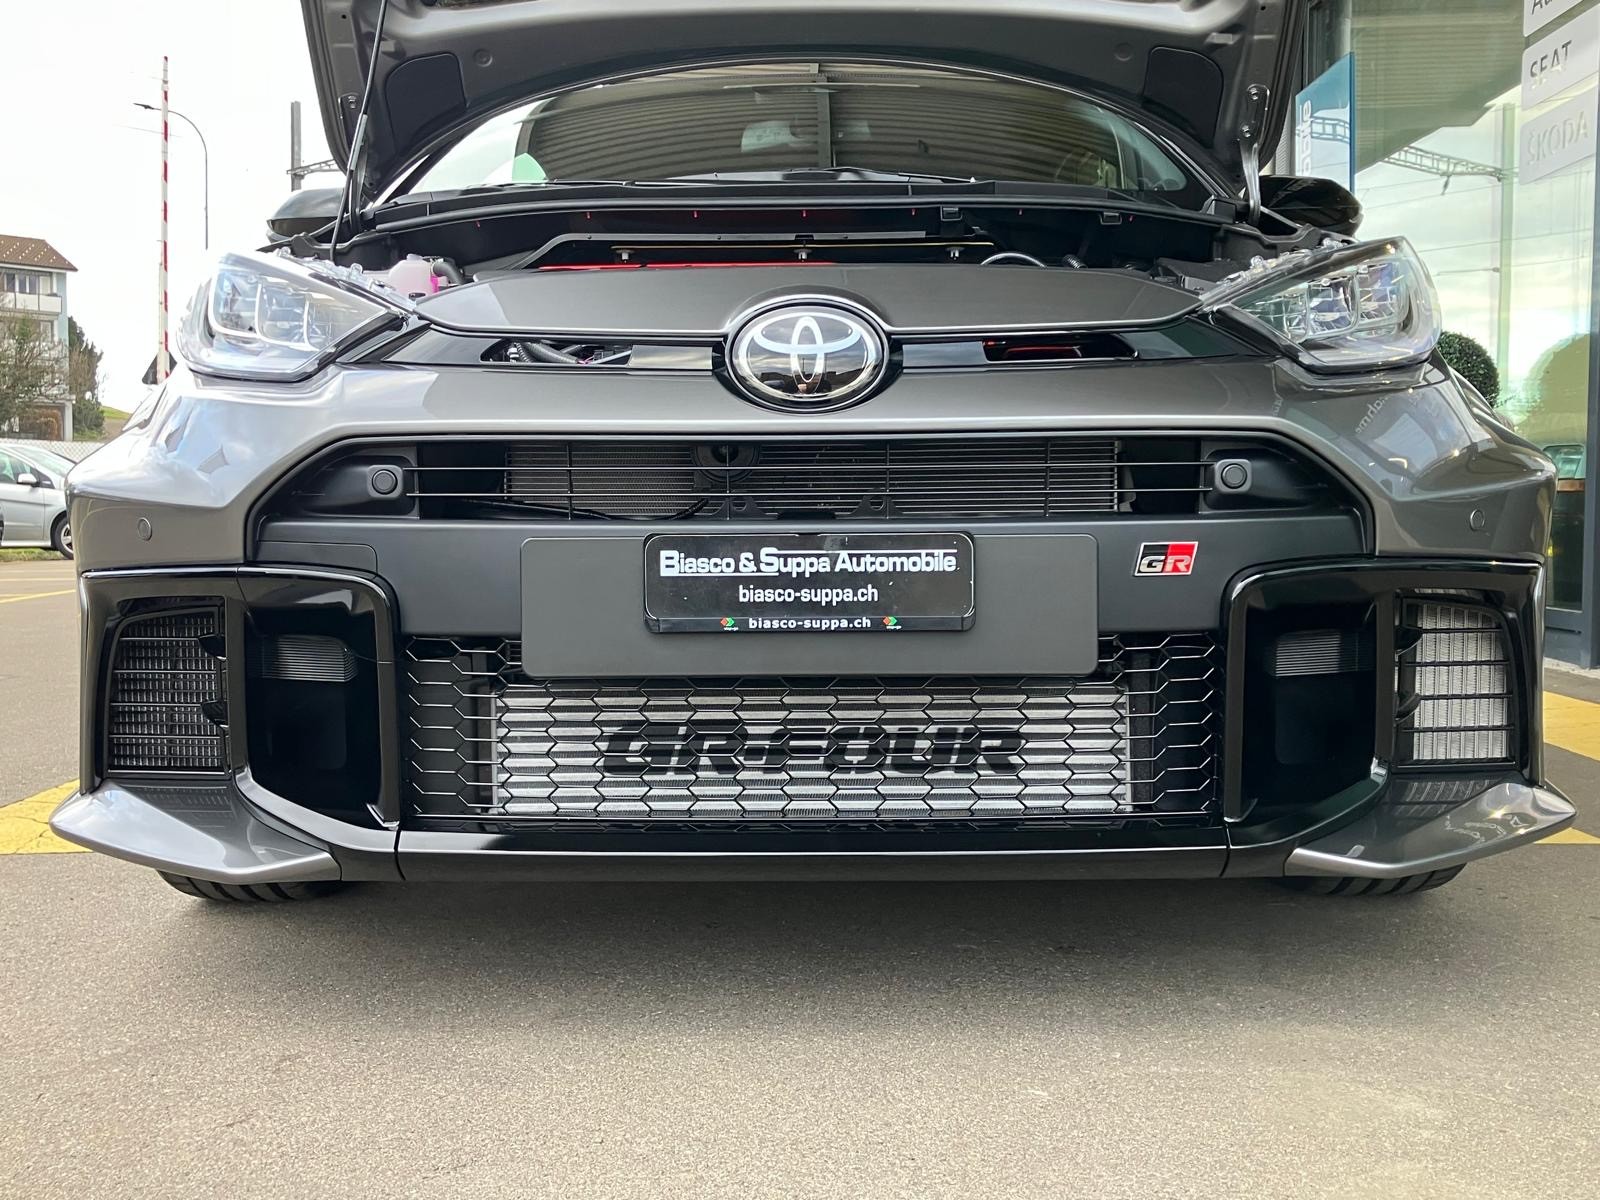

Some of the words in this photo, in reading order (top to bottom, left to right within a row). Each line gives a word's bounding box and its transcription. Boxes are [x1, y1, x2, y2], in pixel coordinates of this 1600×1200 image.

[1530, 40, 1572, 86] SEAT
[660, 550, 735, 576] Biasco
[739, 552, 758, 573] &
[760, 547, 831, 578] Suppa
[834, 551, 957, 573] Automobile
[1139, 555, 1191, 573] GR
[738, 584, 879, 607] biasco-suppa.ch
[748, 617, 871, 630] biasco-suppa.ch
